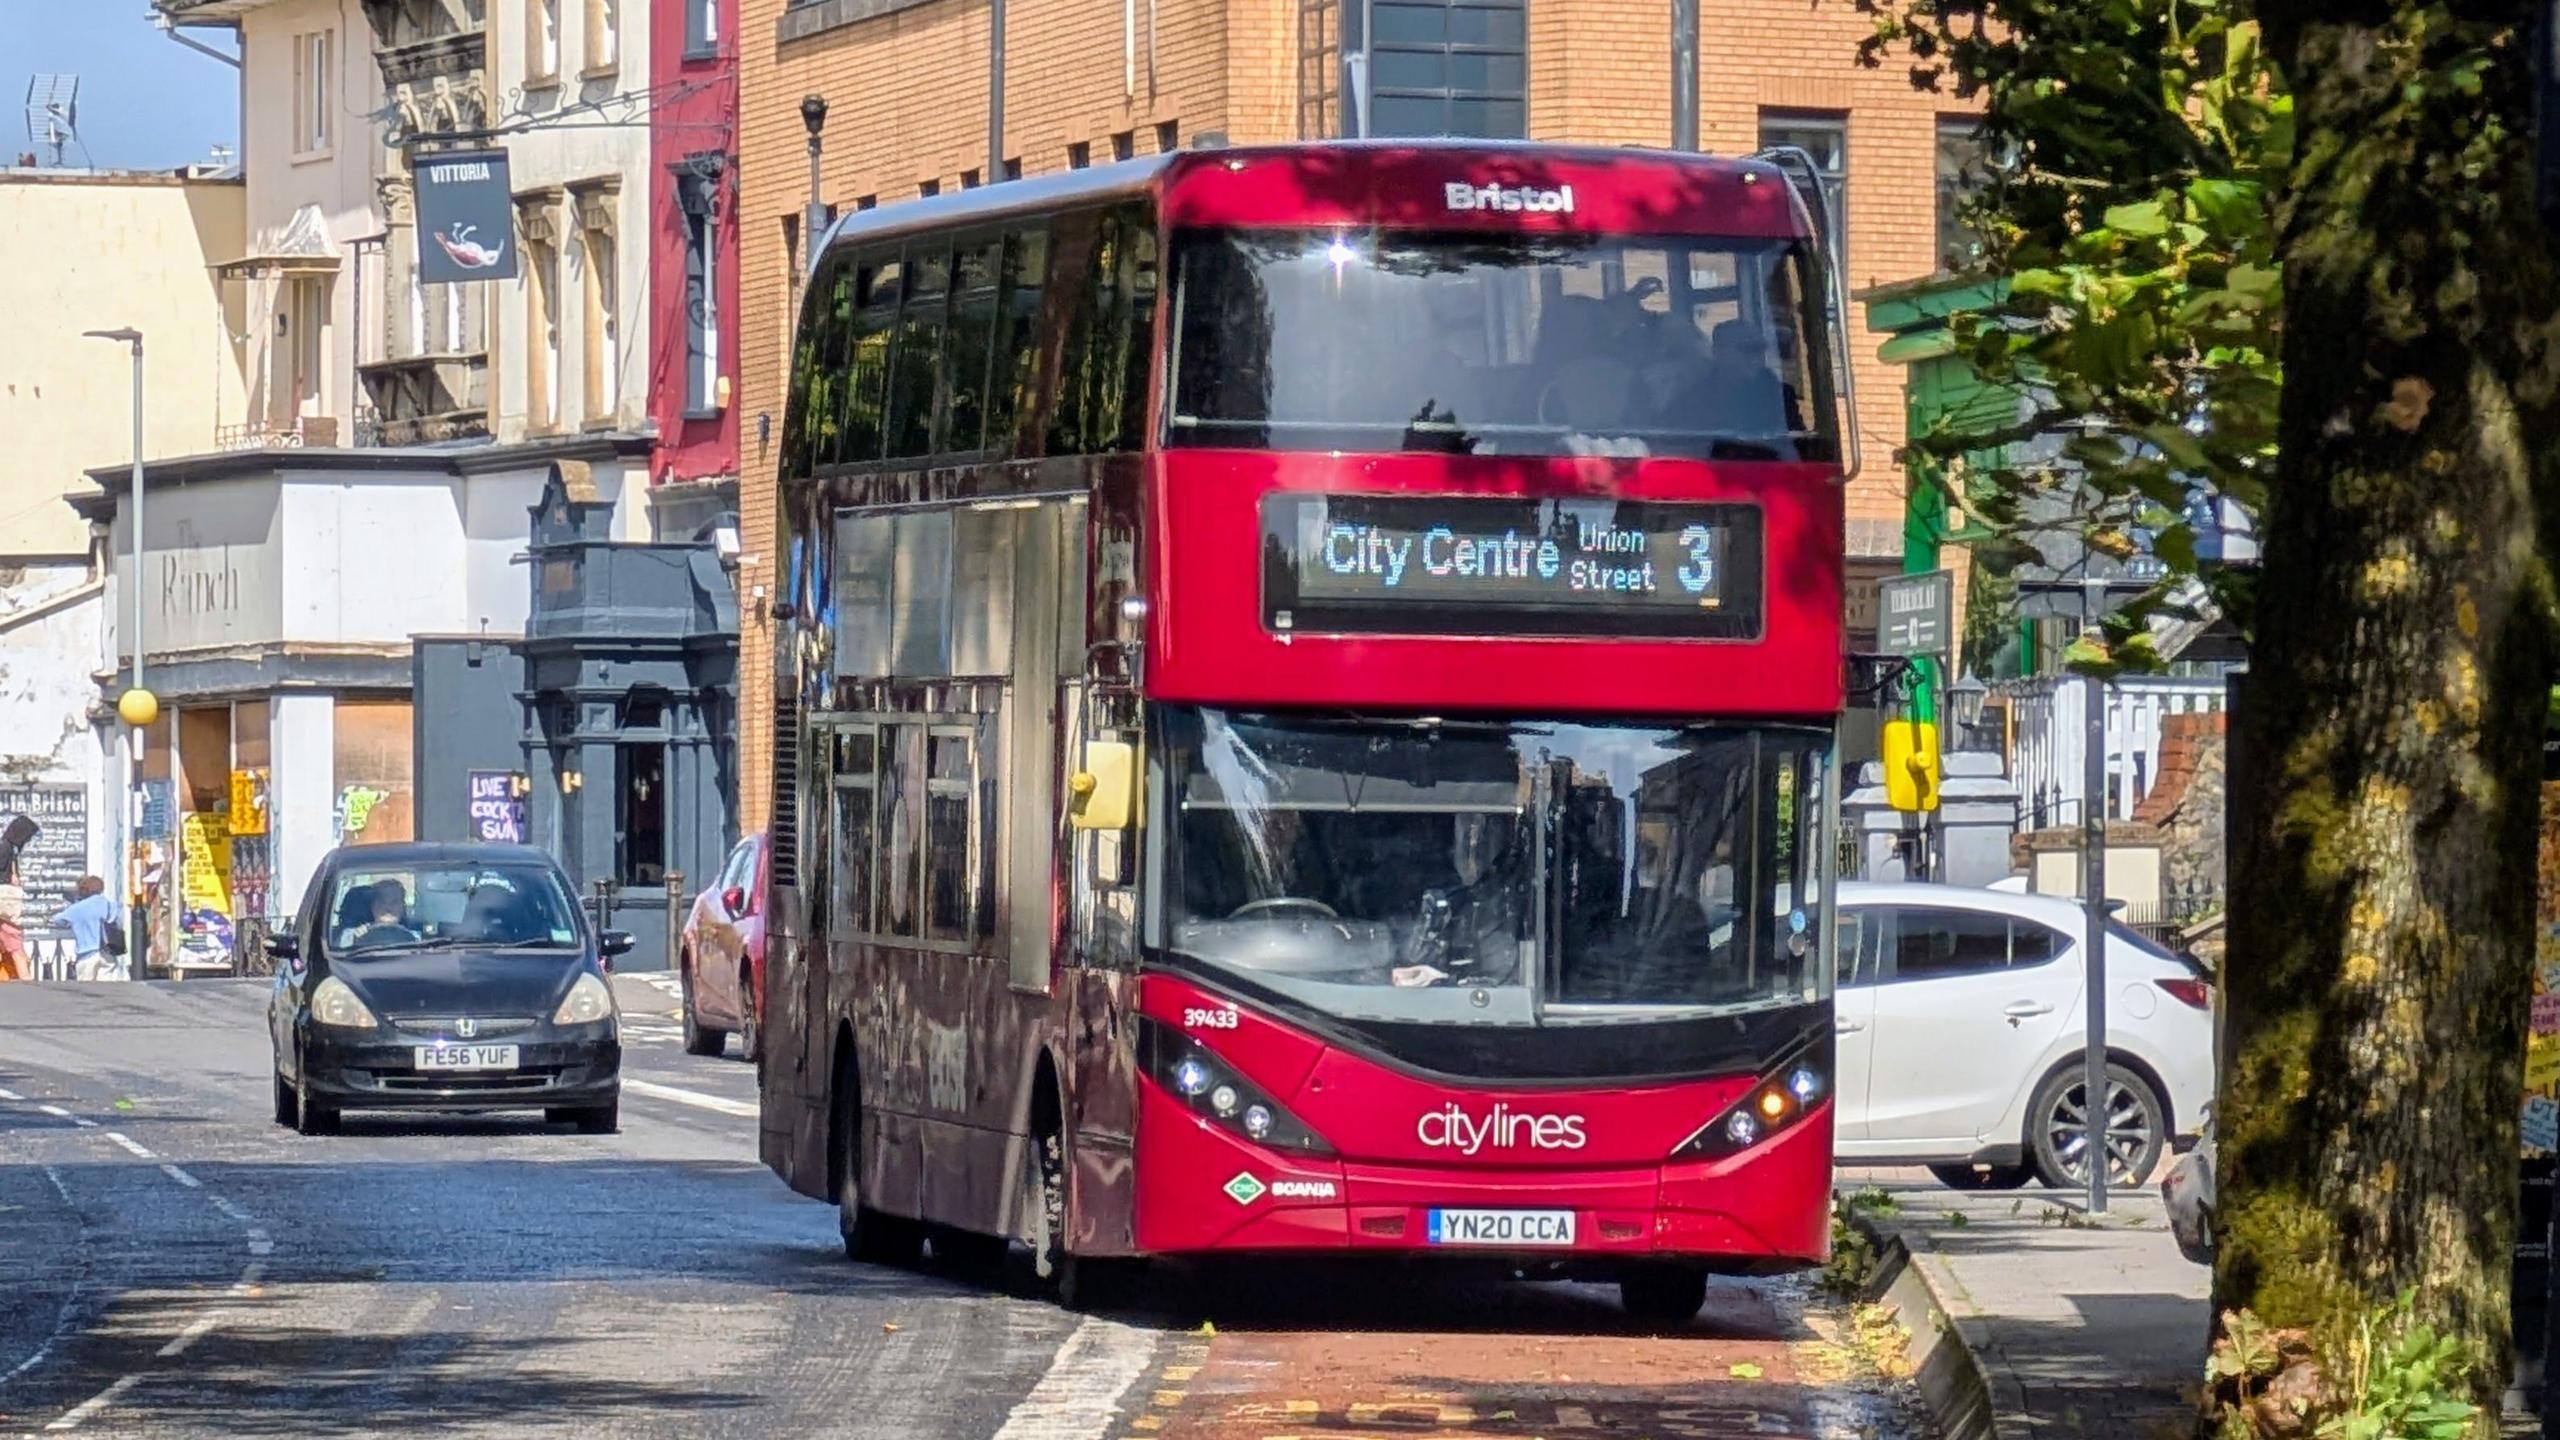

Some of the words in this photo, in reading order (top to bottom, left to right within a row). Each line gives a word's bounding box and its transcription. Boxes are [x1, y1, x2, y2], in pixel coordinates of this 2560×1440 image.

[430, 162, 490, 183] VITTORIA
[1445, 182, 1575, 212] Bristol
[1579, 523, 1645, 553] Union
[1326, 525, 1412, 585] City
[1423, 527, 1559, 578] Centre
[1678, 524, 1713, 592] 3
[1571, 559, 1655, 591] Street
[472, 776, 507, 798] LIVE
[31, 792, 85, 813] Bristol
[1184, 1008, 1239, 1029] 39433
[423, 1049, 471, 1065] FE56
[476, 1048, 510, 1064] YUF
[1417, 1101, 1587, 1155] citylines
[1271, 1182, 1336, 1197] SCANIA
[1446, 1214, 1512, 1239] YN20
[1520, 1216, 1570, 1240] CCA
